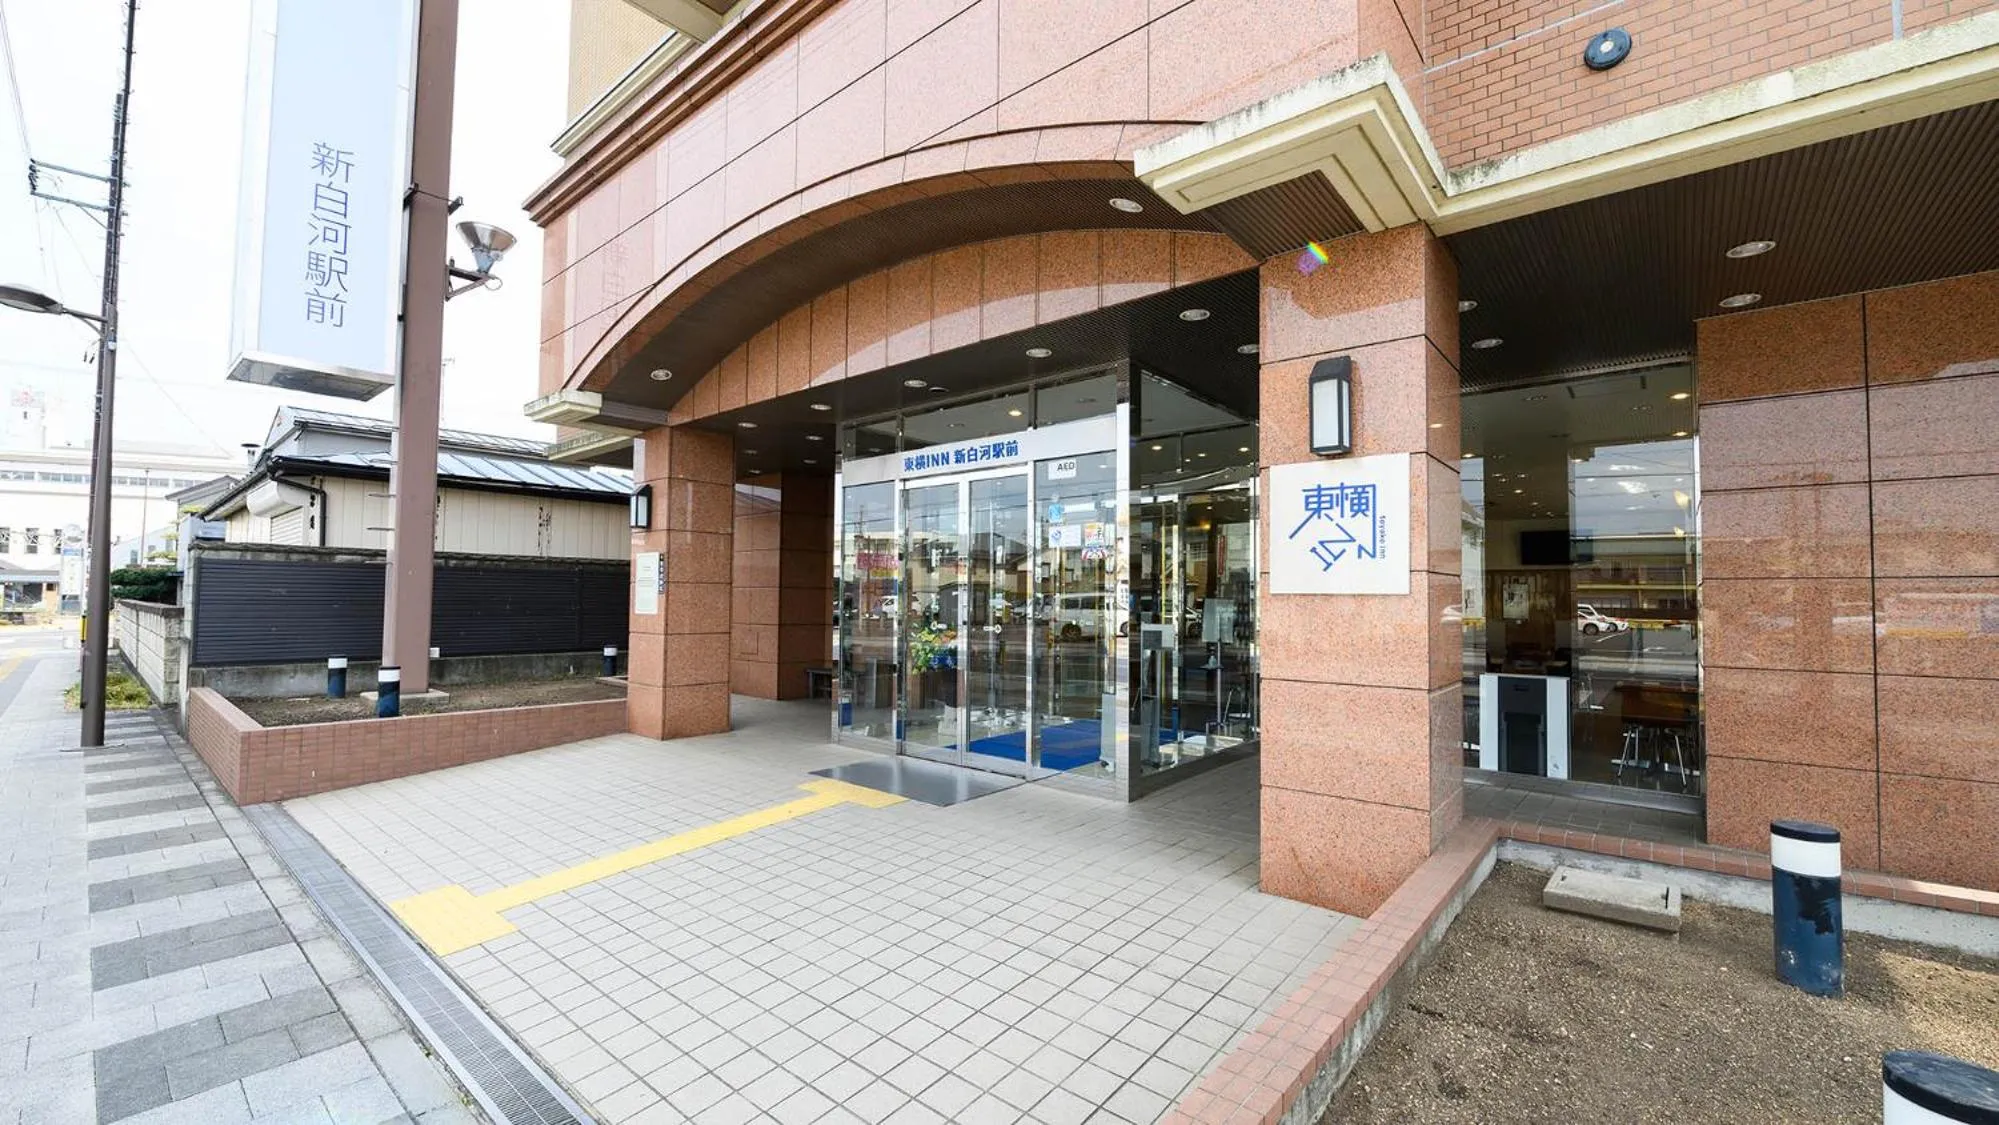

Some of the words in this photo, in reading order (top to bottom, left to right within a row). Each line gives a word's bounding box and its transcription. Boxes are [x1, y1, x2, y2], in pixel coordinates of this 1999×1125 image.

[304, 142, 355, 328] 新白河駅前
[904, 451, 950, 472] 東横INN
[954, 440, 1018, 464] 新白河駅前
[1057, 462, 1075, 471] AED
